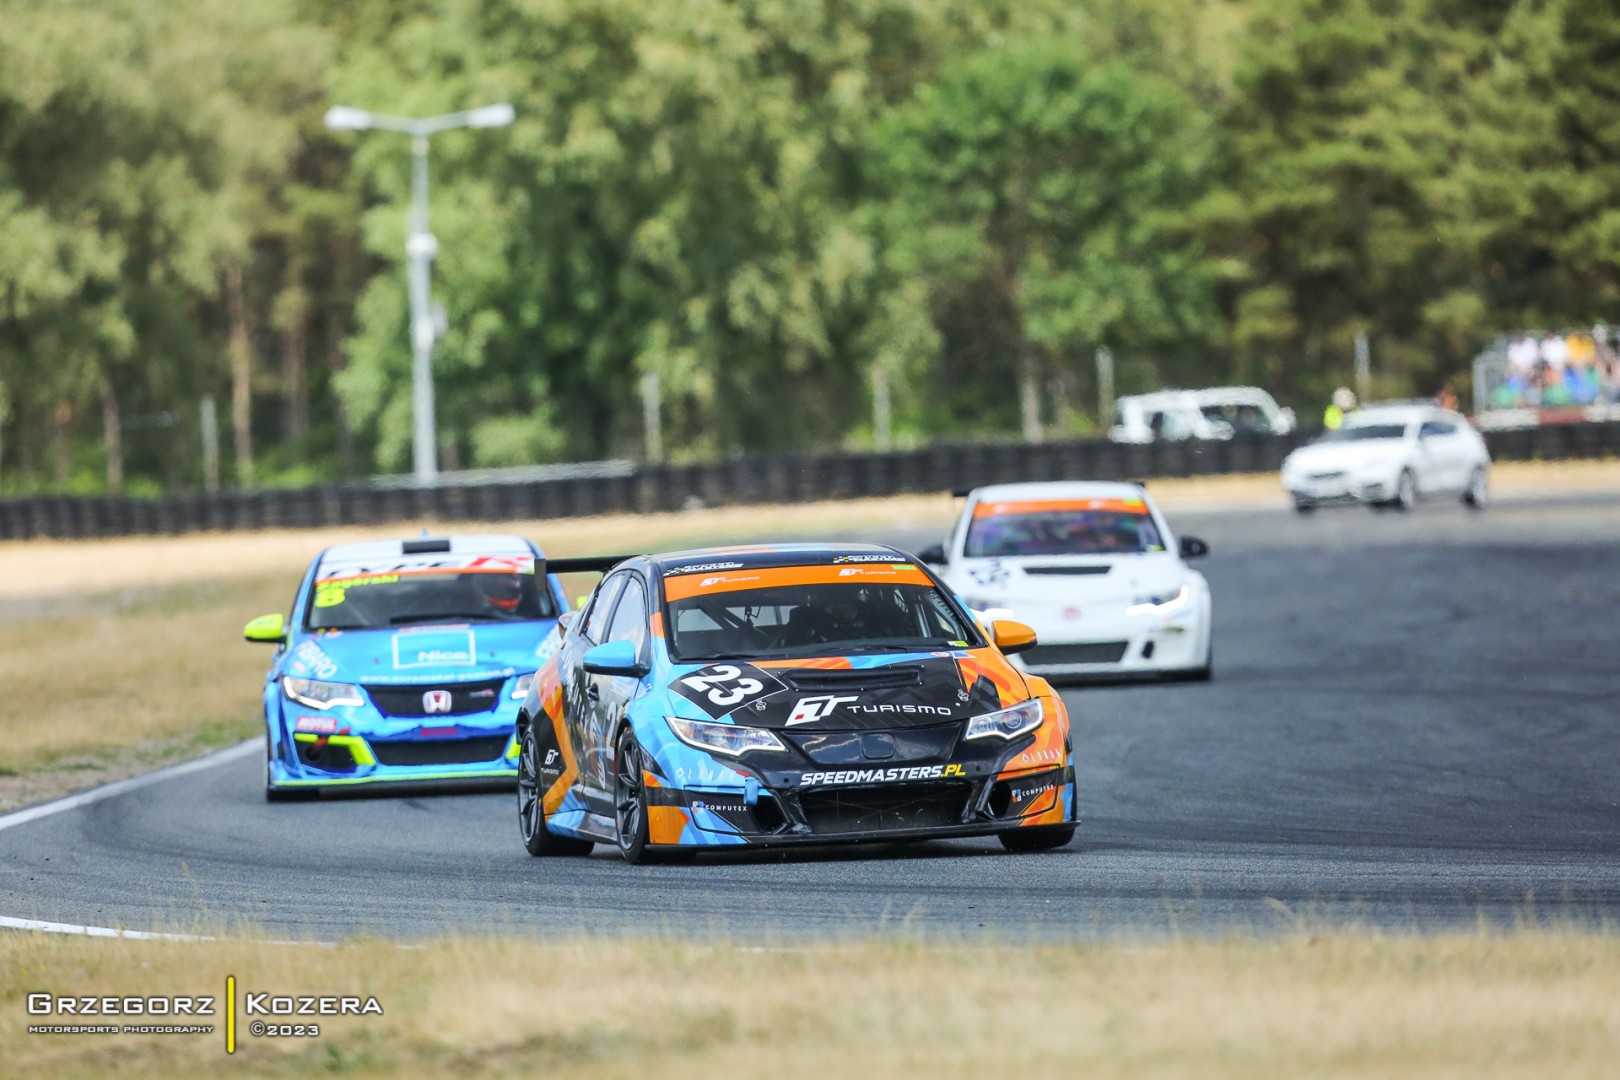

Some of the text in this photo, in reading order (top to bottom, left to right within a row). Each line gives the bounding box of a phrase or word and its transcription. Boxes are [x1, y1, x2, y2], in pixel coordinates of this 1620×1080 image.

[315, 588, 345, 607] 8
[680, 665, 764, 706] 23
[847, 704, 952, 716] TURISMO
[800, 764, 966, 786] SPEEDMASTERS.PL
[705, 804, 748, 812] COMPUTEX
